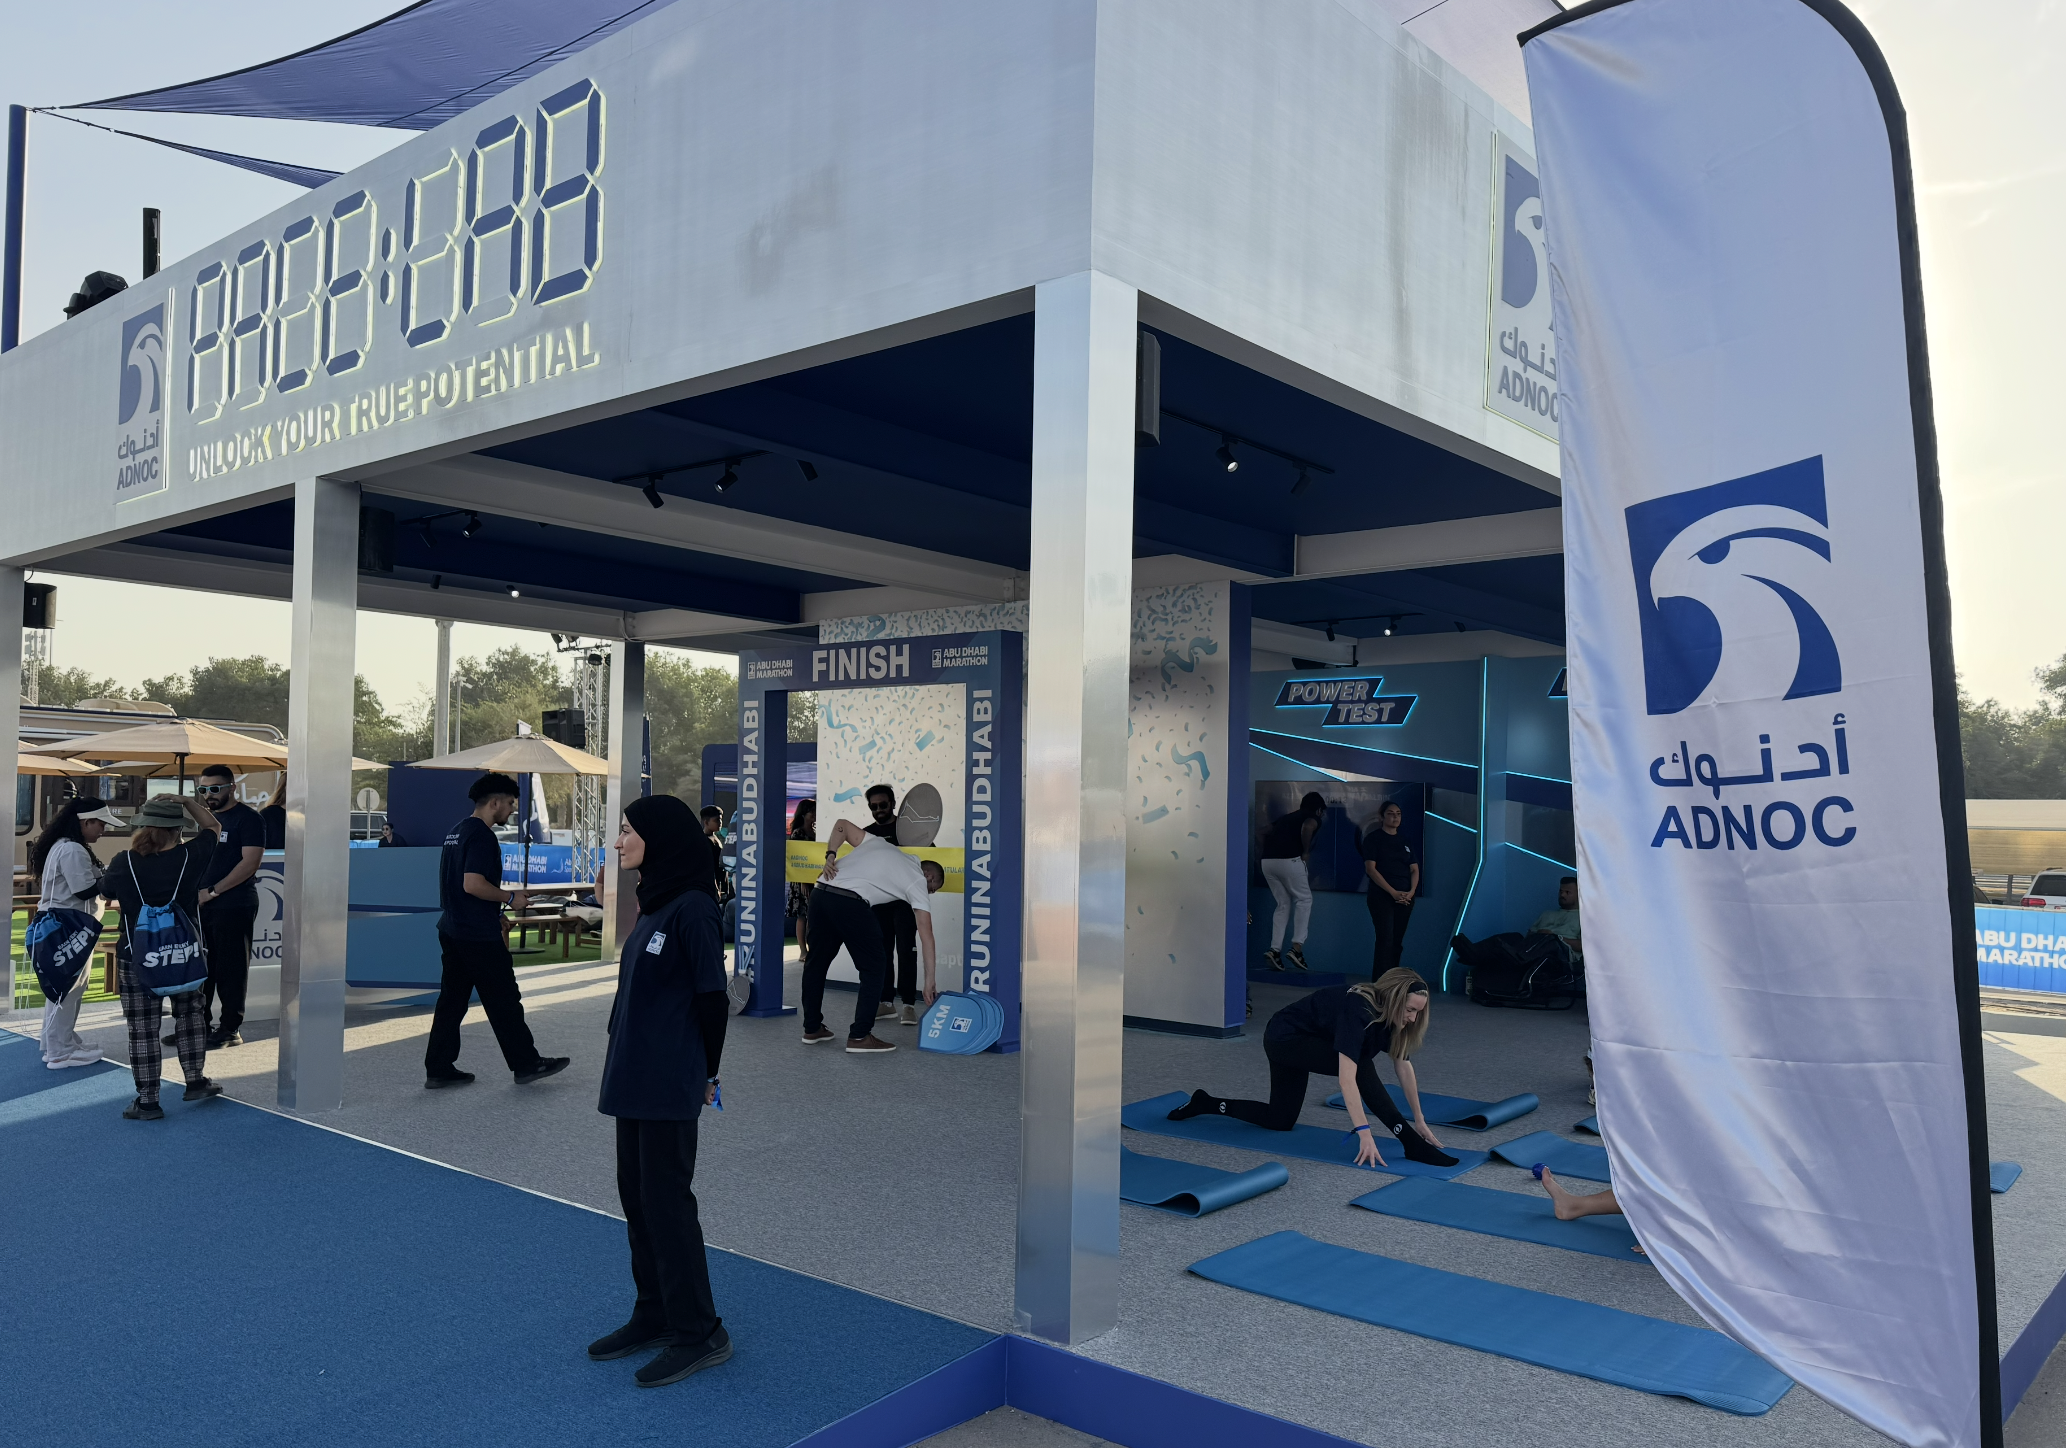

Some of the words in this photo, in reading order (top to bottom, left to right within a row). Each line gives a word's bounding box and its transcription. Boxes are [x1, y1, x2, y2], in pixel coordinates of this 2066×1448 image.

[187, 423, 274, 482] UNLOCK
[277, 403, 341, 457] YOUR
[343, 378, 415, 437] TRUE
[414, 320, 602, 416] POTENTIAL
[117, 418, 161, 462] أدنوك
[116, 456, 159, 491] ADNOC
[756, 661, 771, 670] ABU
[771, 659, 793, 669] DHABI
[812, 643, 910, 682] FINISH
[943, 648, 961, 658] ABU
[962, 646, 988, 656] DHABI
[943, 656, 988, 668] MARATHON
[756, 669, 793, 679] MARATHON
[1287, 681, 1369, 703] POWER
[1336, 702, 1396, 723] TEST
[1649, 712, 1850, 801] أدنوك
[1650, 795, 1857, 851] ADNOC
[53, 926, 95, 967] STEP!
[142, 941, 200, 968] STEP!
[927, 1004, 951, 1039] 5KM
